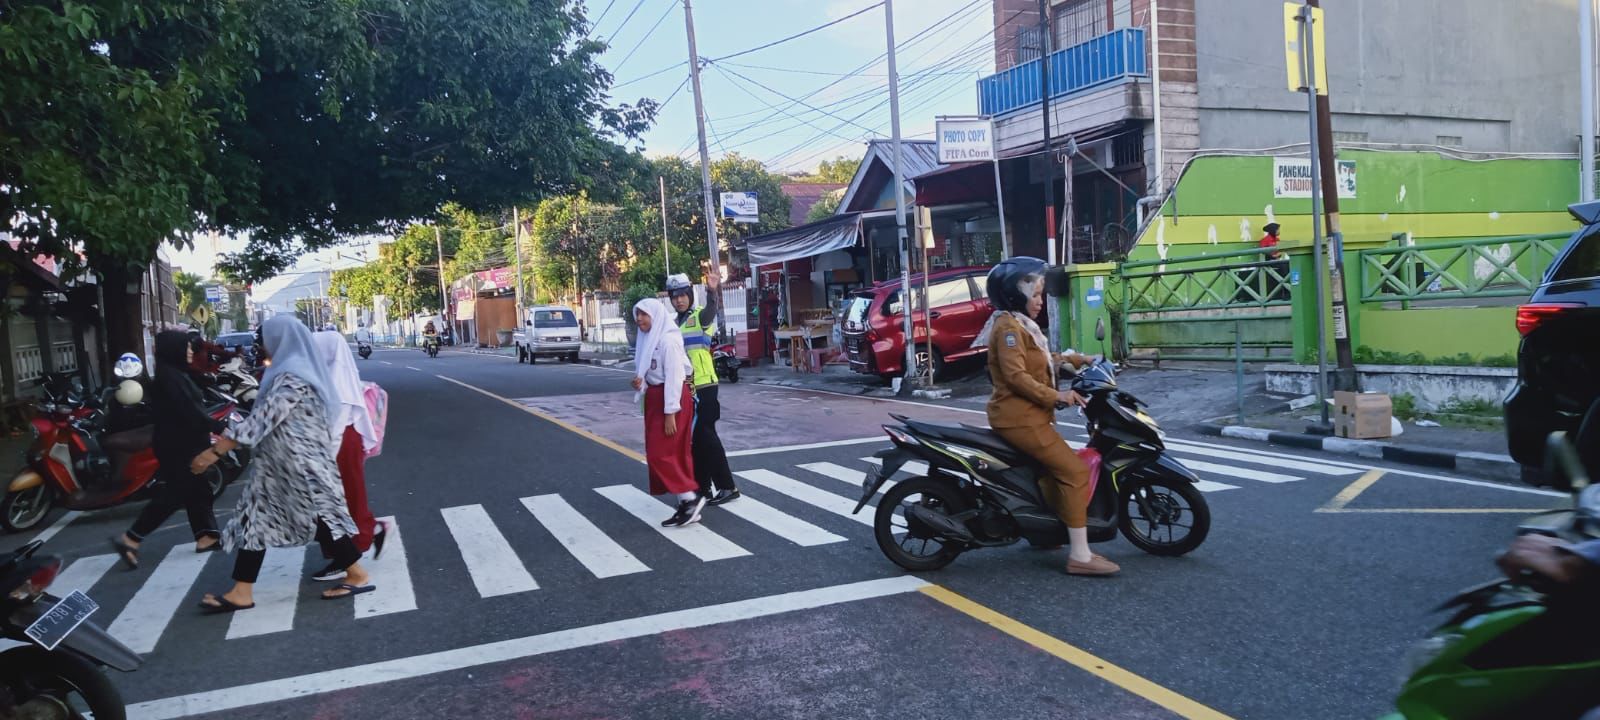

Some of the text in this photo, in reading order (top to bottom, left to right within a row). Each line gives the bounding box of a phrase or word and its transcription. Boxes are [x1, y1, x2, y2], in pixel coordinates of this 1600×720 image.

[943, 129, 986, 143] PHOTO COPY
[945, 148, 990, 159] FIFA Com
